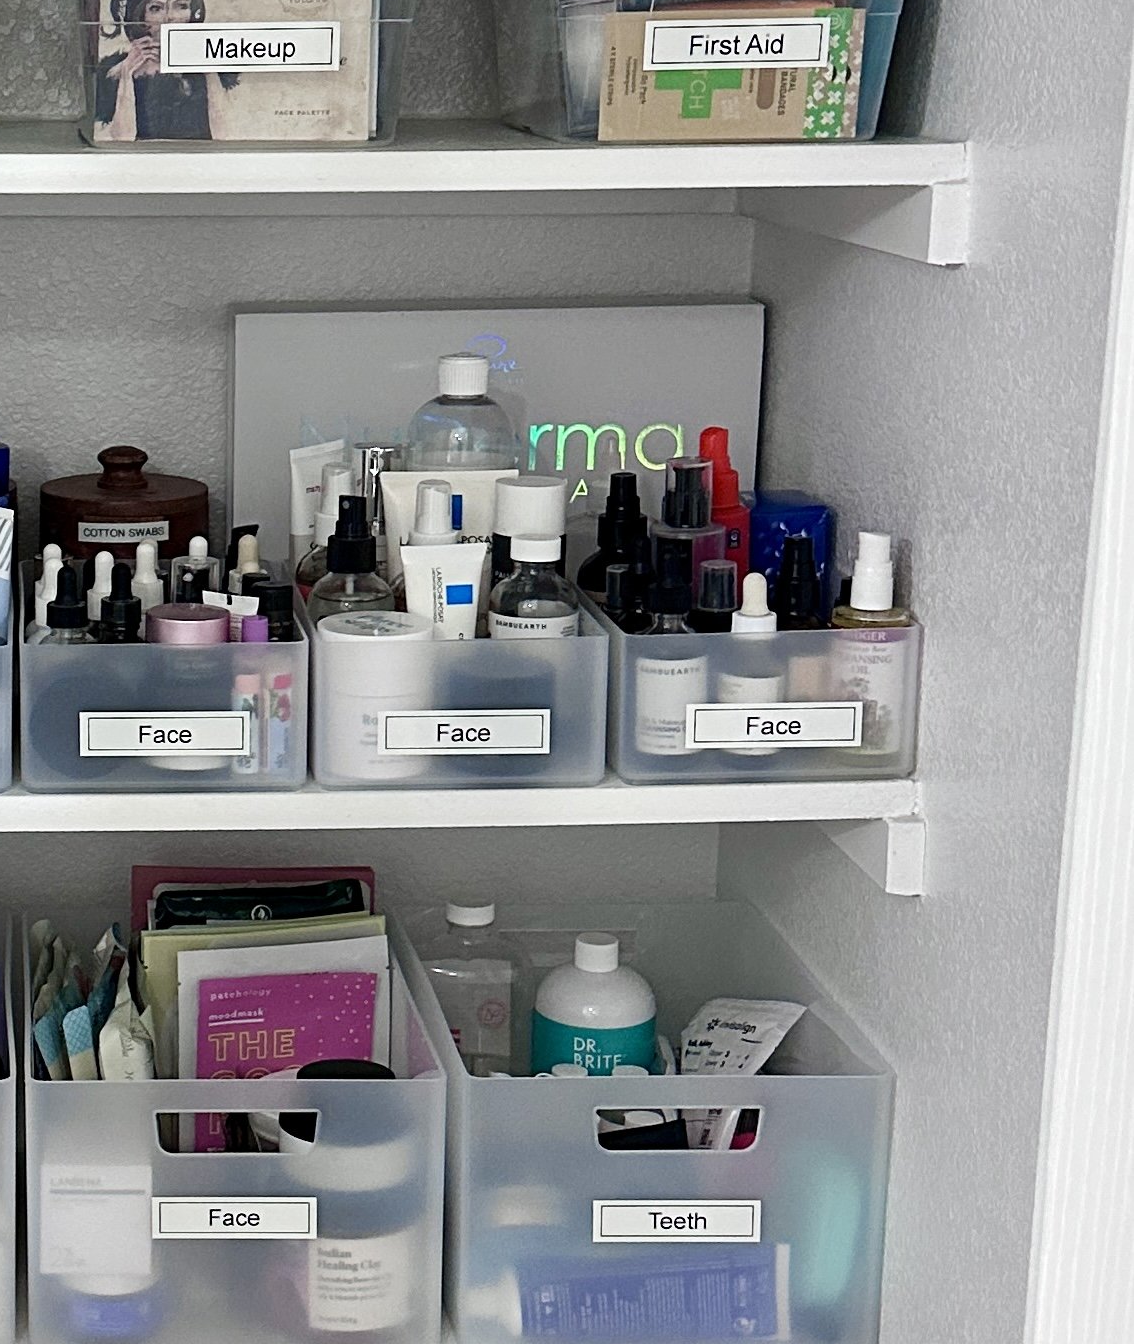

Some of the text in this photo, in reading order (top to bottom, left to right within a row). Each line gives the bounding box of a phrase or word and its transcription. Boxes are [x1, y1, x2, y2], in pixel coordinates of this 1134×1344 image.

[206, 38, 295, 62] Makeup
[690, 34, 784, 55] First Aid
[82, 525, 165, 538] COTTON SWABS
[140, 726, 191, 743] Face
[438, 724, 490, 742] Face
[747, 717, 801, 735] Face
[208, 1008, 265, 1021] moodmask
[207, 1028, 296, 1062] THE
[573, 1037, 602, 1053] DR.
[573, 1053, 624, 1070] BRITE
[210, 1209, 260, 1226] Face
[649, 1212, 706, 1229] Teeth
